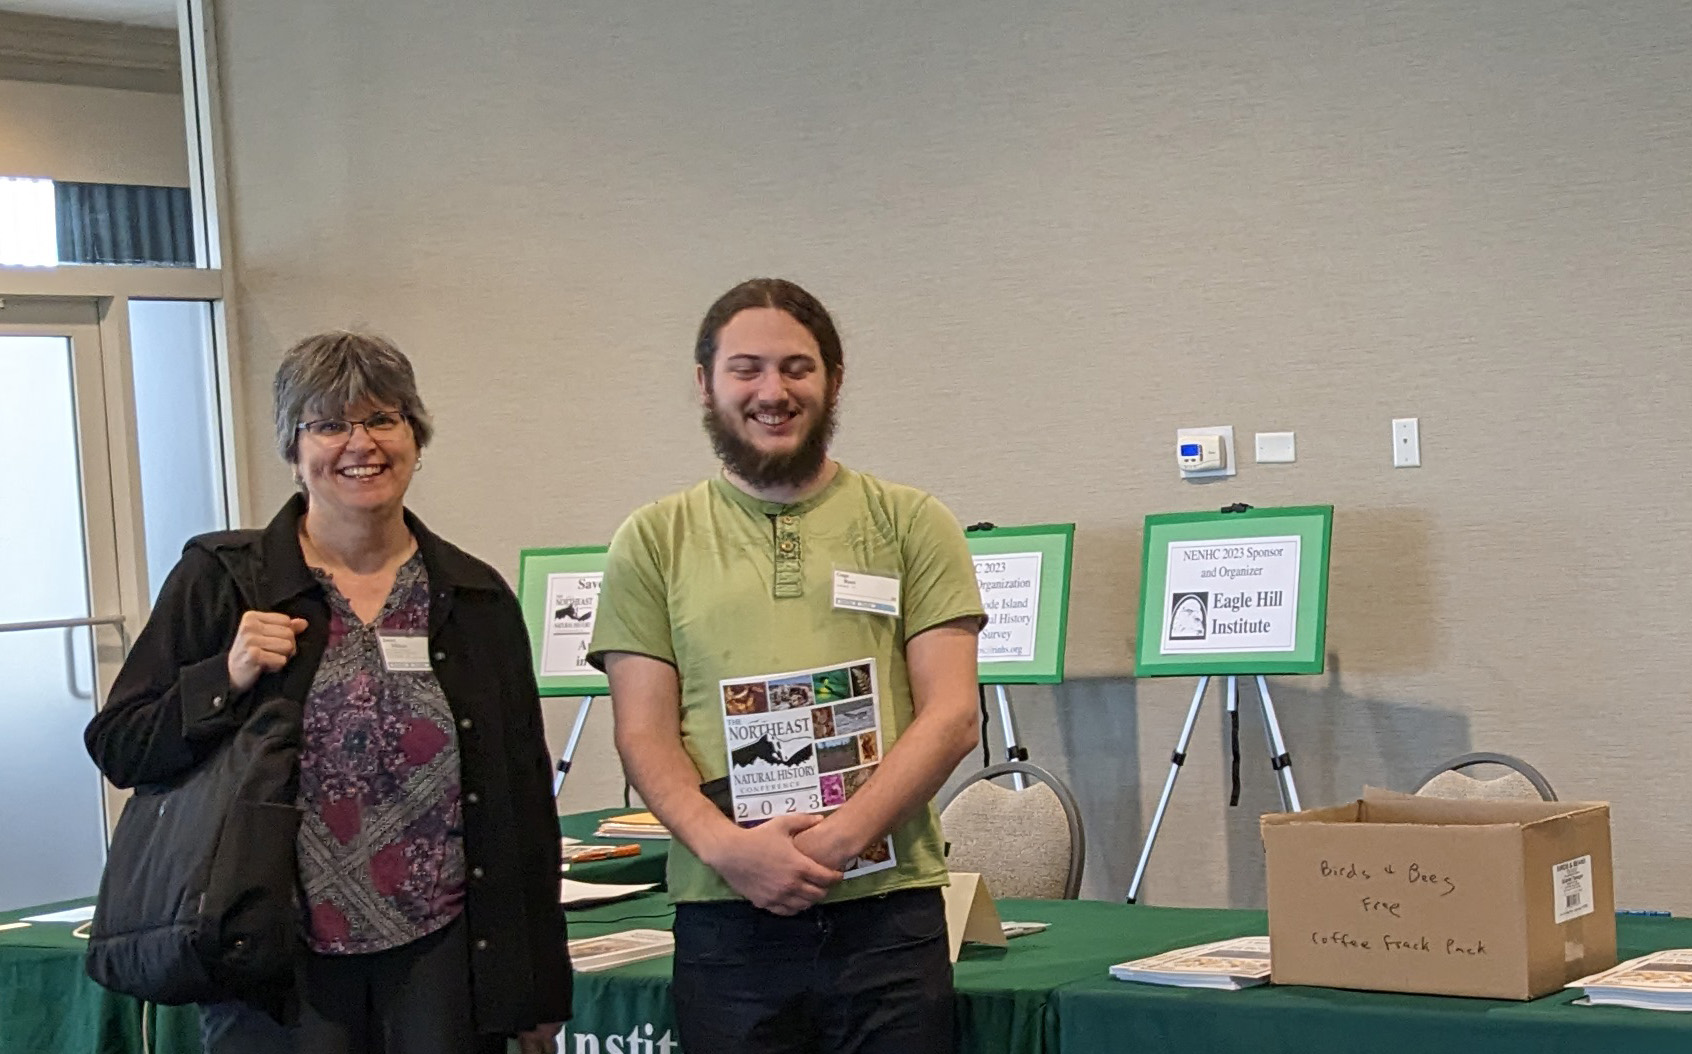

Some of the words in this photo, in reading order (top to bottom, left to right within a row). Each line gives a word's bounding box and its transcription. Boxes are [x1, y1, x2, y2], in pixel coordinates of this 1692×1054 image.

[1183, 549, 1220, 561] NENHC
[1222, 547, 1244, 559] 2023
[1246, 546, 1283, 561] Sponsor
[984, 562, 1006, 573] 2023
[1200, 567, 1217, 578] and
[1219, 565, 1263, 579] Organizer
[1213, 592, 1252, 612] Eagle
[1256, 590, 1283, 608] Hill
[1211, 618, 1271, 635] Institute
[729, 717, 811, 741] NORTHEAST
[733, 769, 775, 786] NATURAL
[776, 765, 816, 780] HISTORY
[740, 781, 801, 794] CONFERENCE
[1320, 859, 1371, 879] Birds
